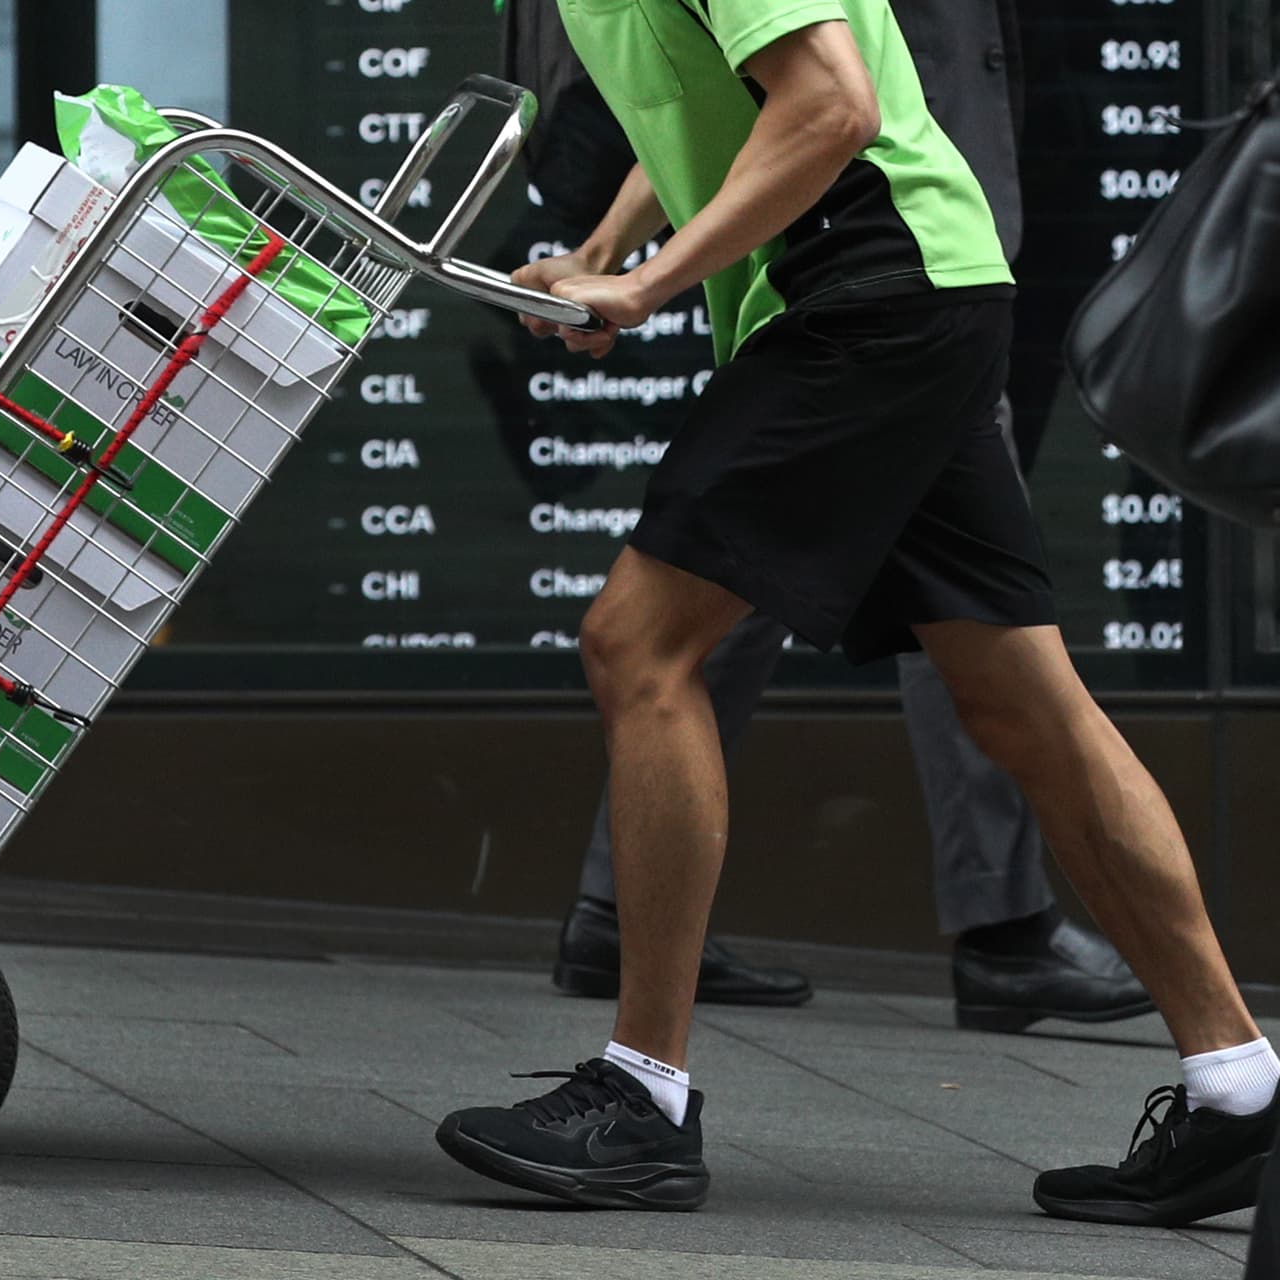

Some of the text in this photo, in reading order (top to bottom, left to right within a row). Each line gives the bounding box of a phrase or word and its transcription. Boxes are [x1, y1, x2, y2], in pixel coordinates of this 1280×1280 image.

[359, 48, 429, 79] COF
[359, 113, 421, 144] CTT
[55, 337, 98, 370] LAW
[95, 366, 121, 391] IN
[360, 375, 422, 405] CEL
[528, 371, 686, 406] Challenger
[360, 439, 419, 470] CIA
[361, 505, 435, 536] CCA
[362, 571, 418, 600] CHI
